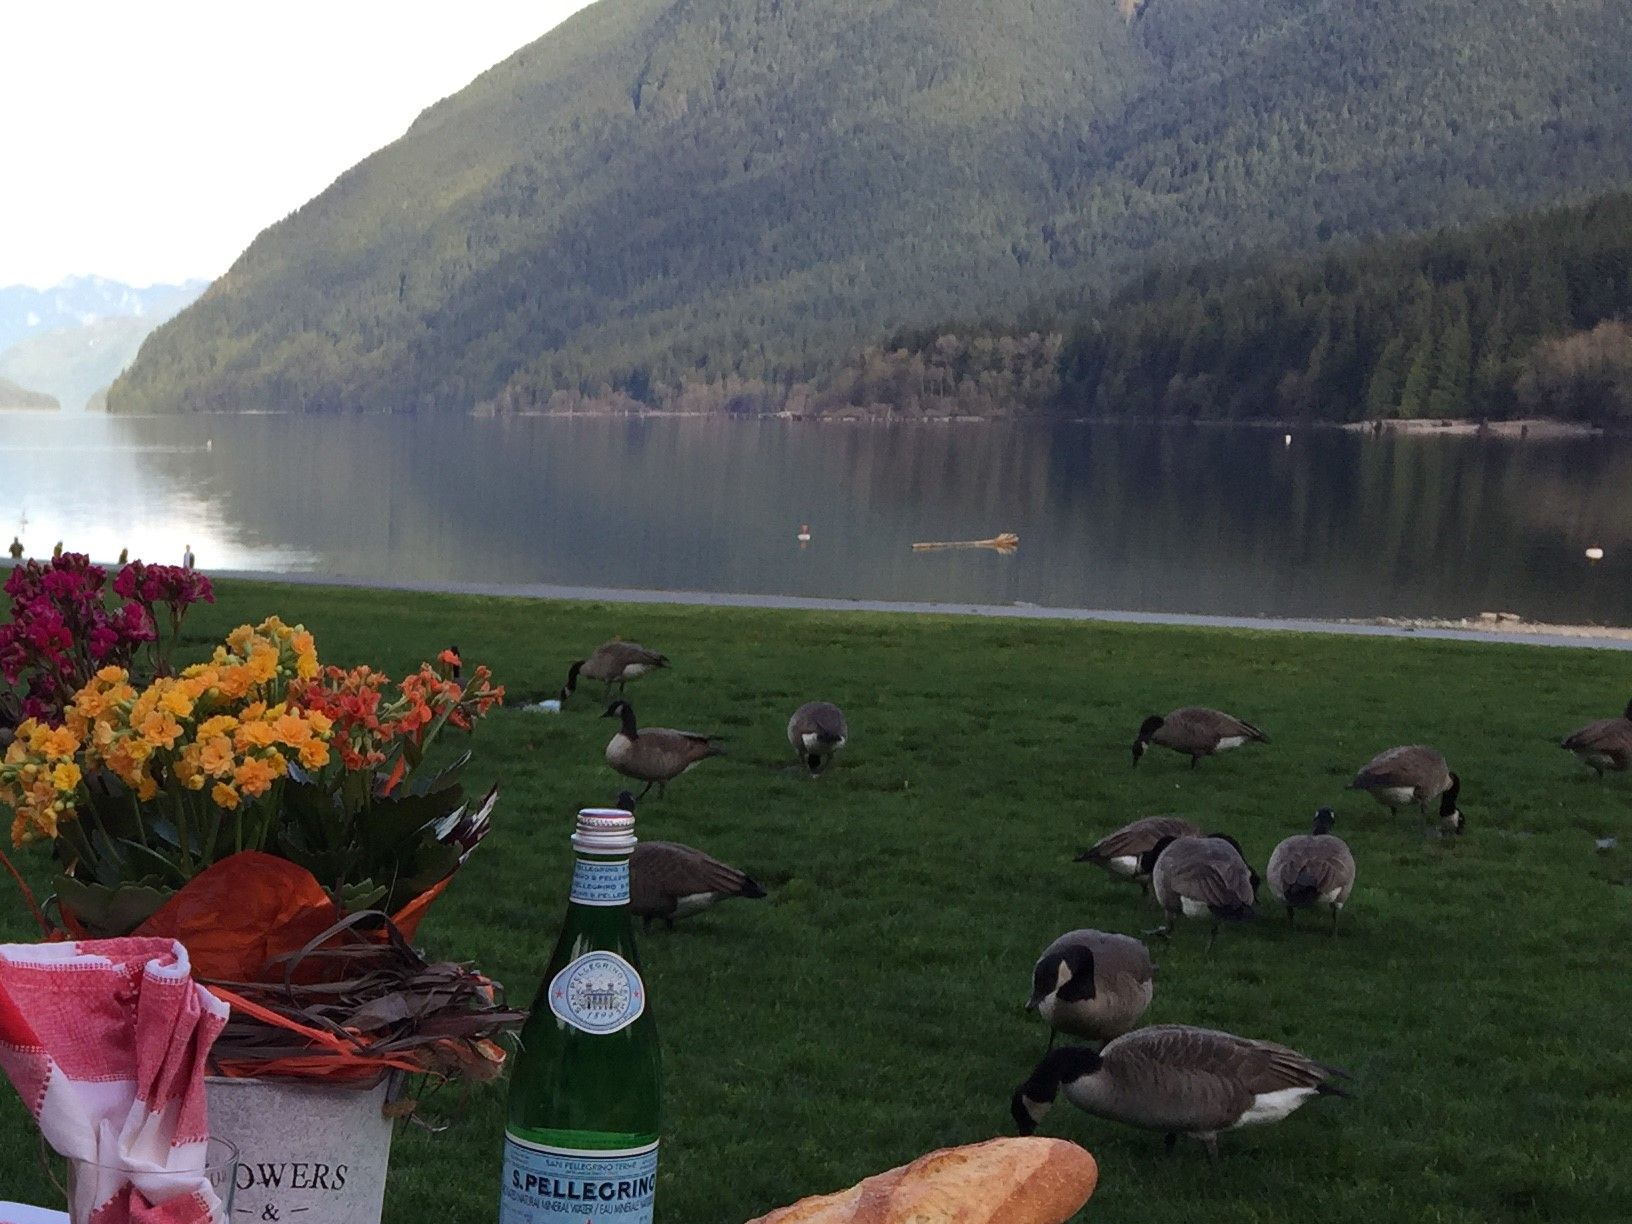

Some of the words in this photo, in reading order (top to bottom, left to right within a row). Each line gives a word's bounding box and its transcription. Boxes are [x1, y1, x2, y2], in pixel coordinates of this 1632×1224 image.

[236, 1162, 348, 1191] OWERS
[512, 1169, 656, 1201] S.PELLEGRINO
[261, 1203, 280, 1221] &
